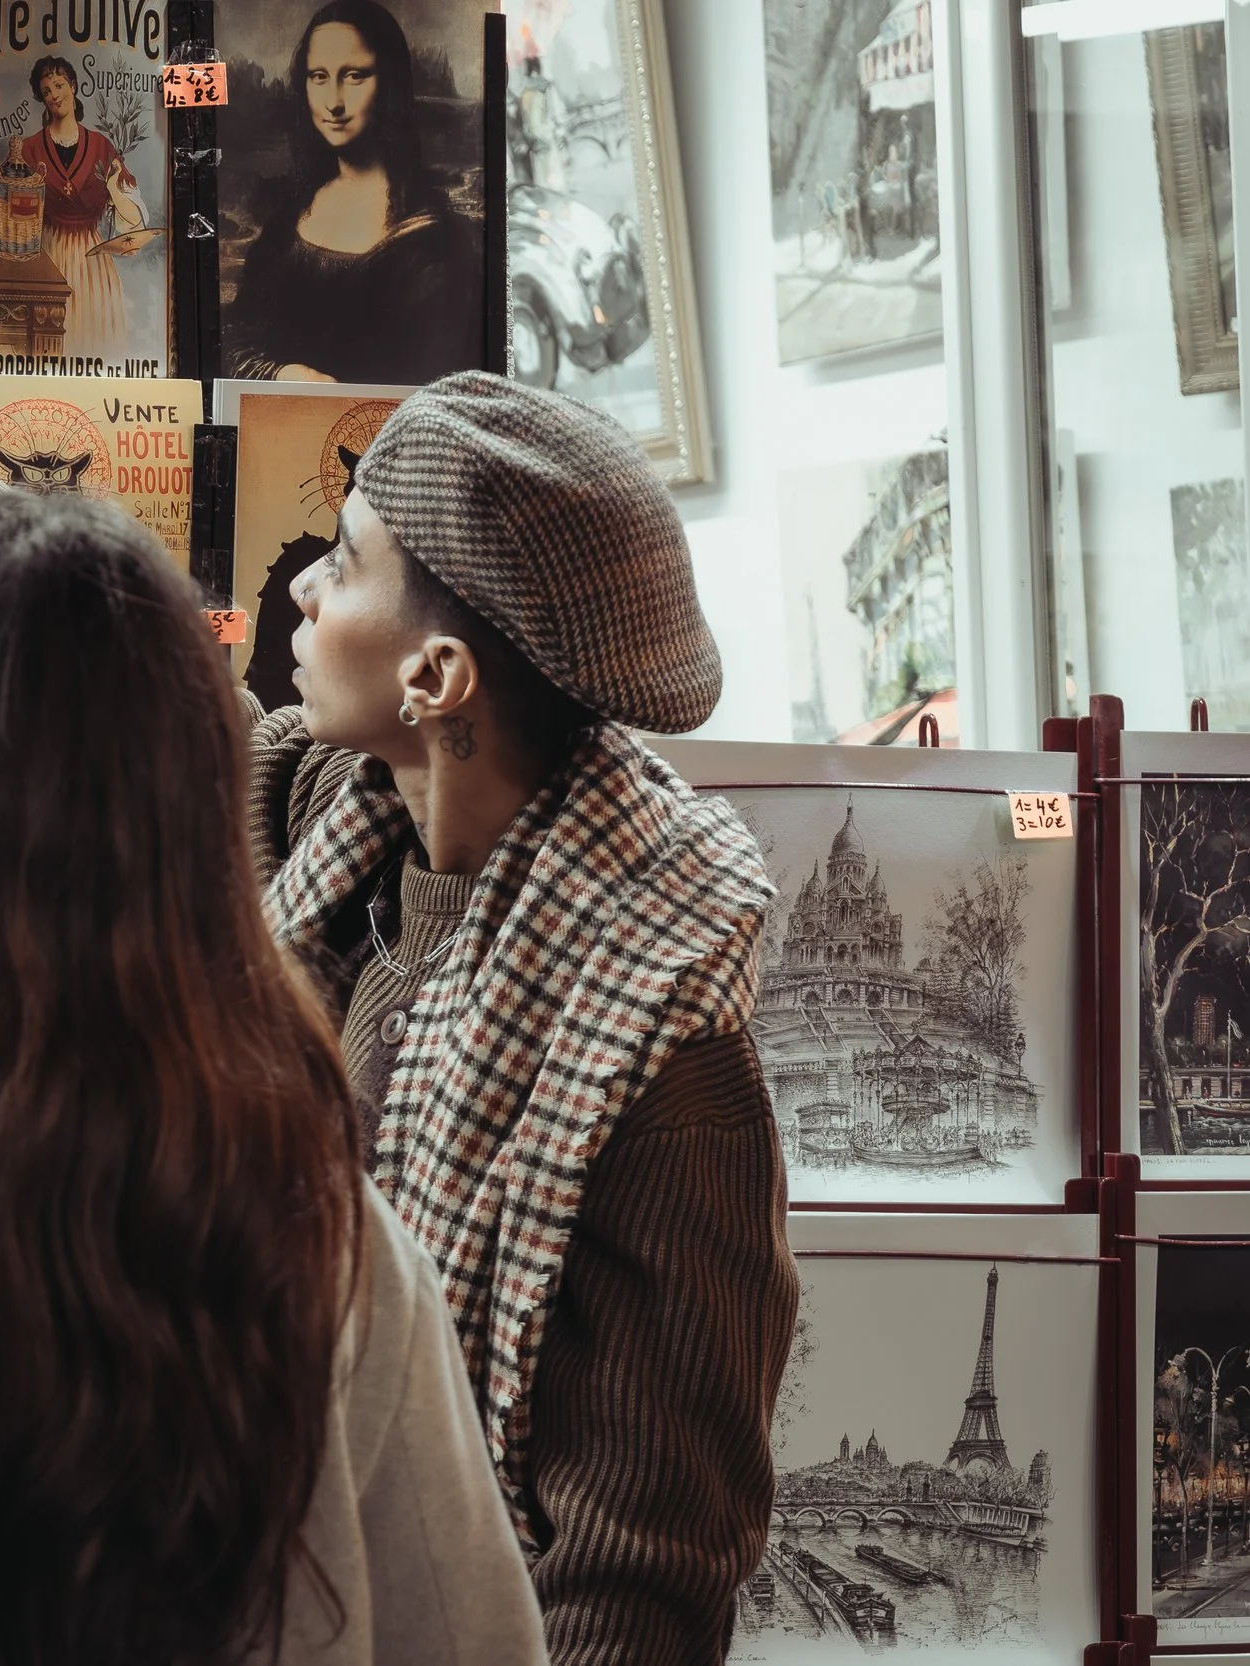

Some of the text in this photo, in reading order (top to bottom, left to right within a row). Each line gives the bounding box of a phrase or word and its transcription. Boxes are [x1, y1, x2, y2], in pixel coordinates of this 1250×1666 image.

[42, 0, 160, 60] dOlive
[103, 397, 179, 424] VENTE
[116, 424, 189, 460] HÔTEL
[117, 465, 193, 496] DROUOT
[134, 500, 168, 519] Salle
